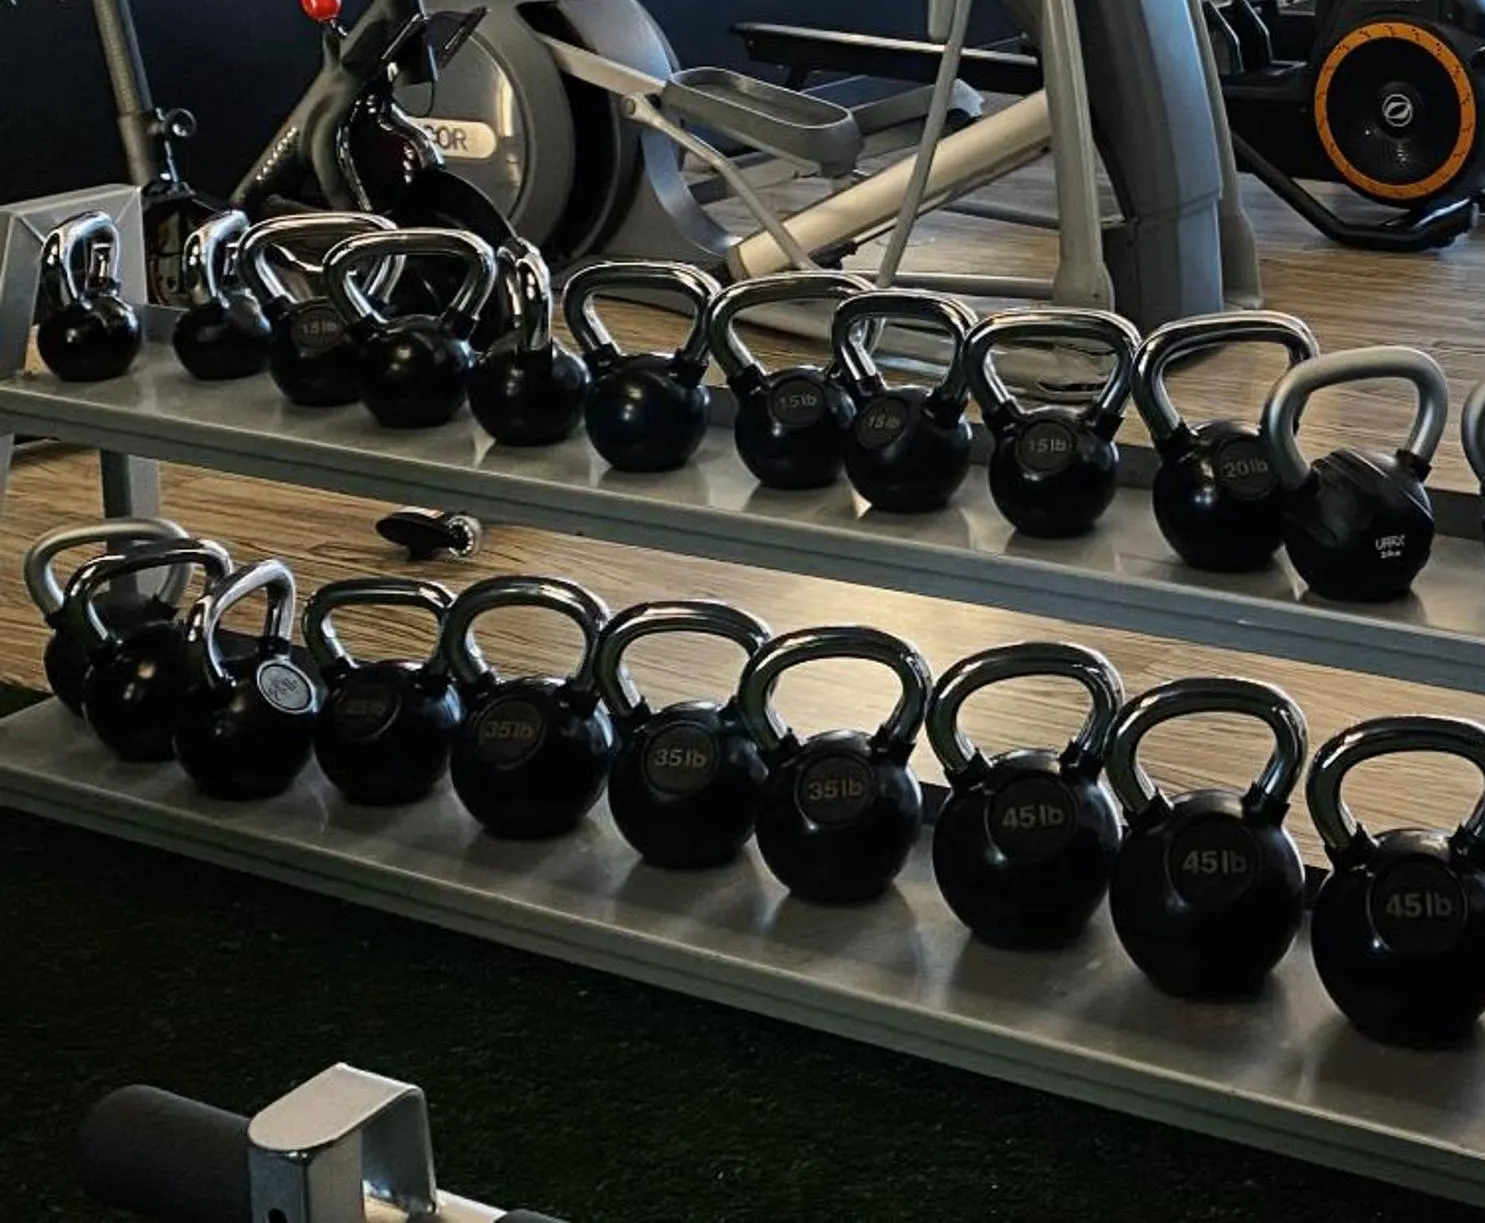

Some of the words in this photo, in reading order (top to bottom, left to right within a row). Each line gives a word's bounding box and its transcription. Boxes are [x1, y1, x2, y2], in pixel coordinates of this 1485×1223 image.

[780, 392, 818, 409] 15lb
[1028, 437, 1067, 453] 15lb
[1221, 460, 1269, 479] 20lb
[485, 719, 534, 739] 35lb
[653, 748, 707, 768] 35lb
[808, 778, 864, 801] 35lb
[1001, 804, 1065, 828] 45lb
[1181, 849, 1248, 875] 45lb
[1386, 892, 1451, 918] 45lb
